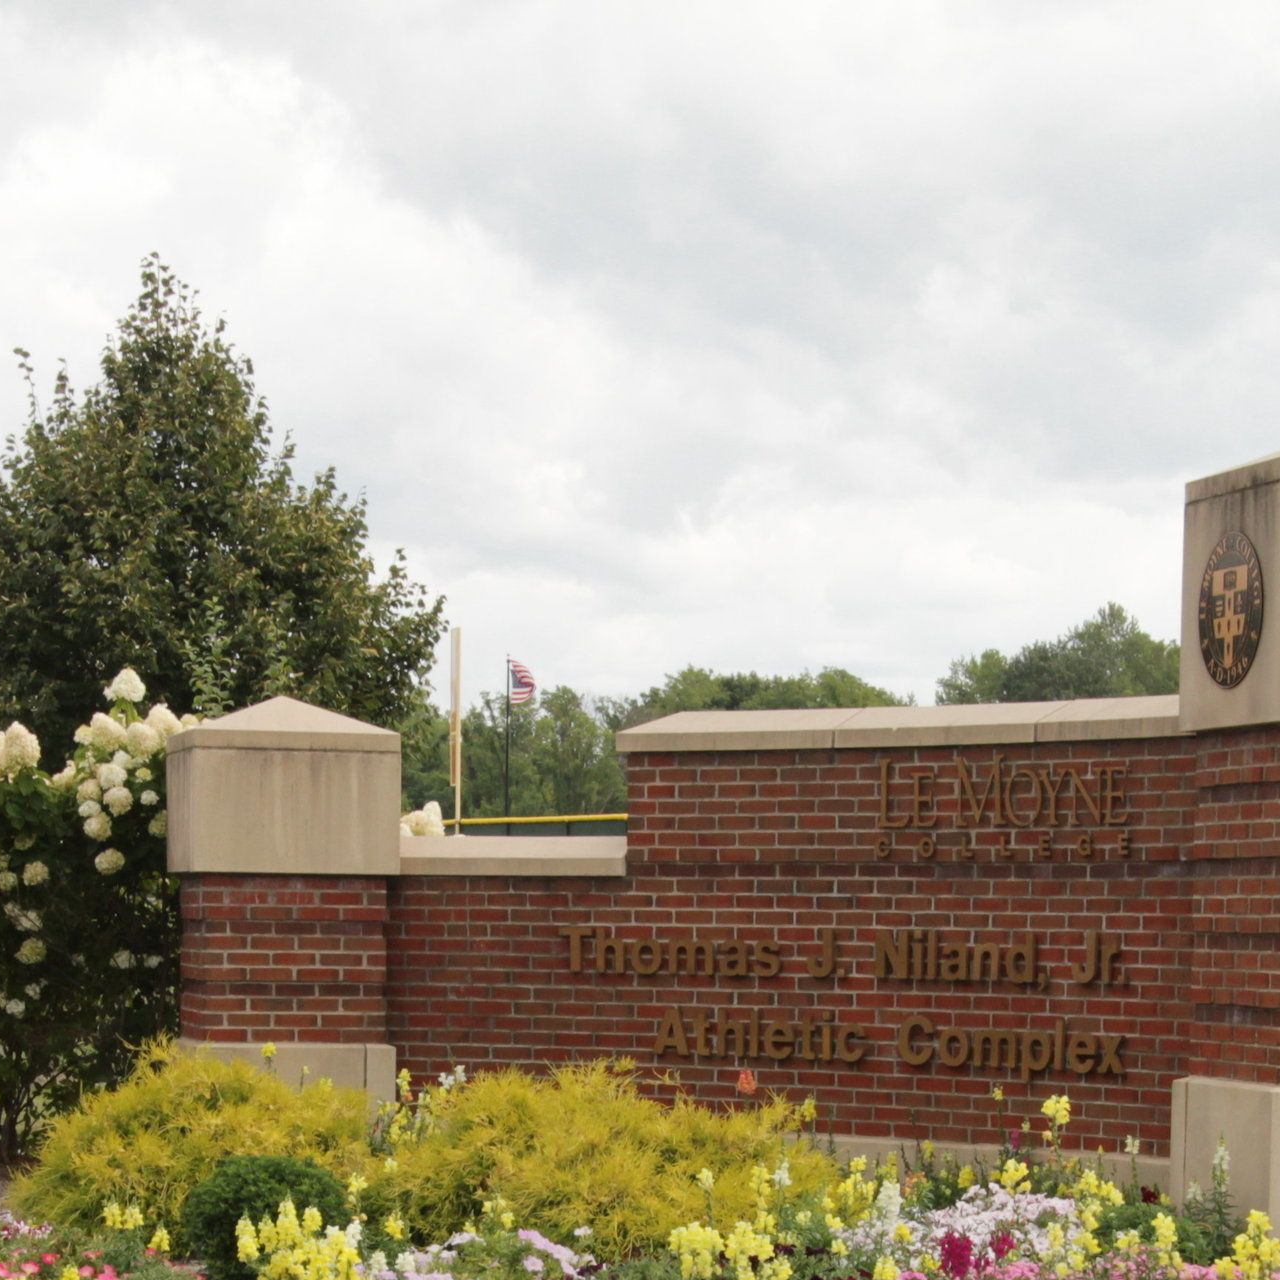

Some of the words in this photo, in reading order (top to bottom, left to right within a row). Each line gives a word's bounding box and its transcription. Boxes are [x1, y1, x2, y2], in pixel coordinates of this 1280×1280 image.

[877, 758, 937, 829] LE
[953, 753, 1130, 828] MOYNE
[875, 834, 1130, 858] COLLEGE
[558, 926, 782, 978] Thomas
[806, 927, 846, 978] J.
[874, 929, 1050, 991] Niland,
[1070, 930, 1129, 985] Jr.
[652, 1006, 867, 1064] Athletic
[897, 1014, 1127, 1082] Complex
